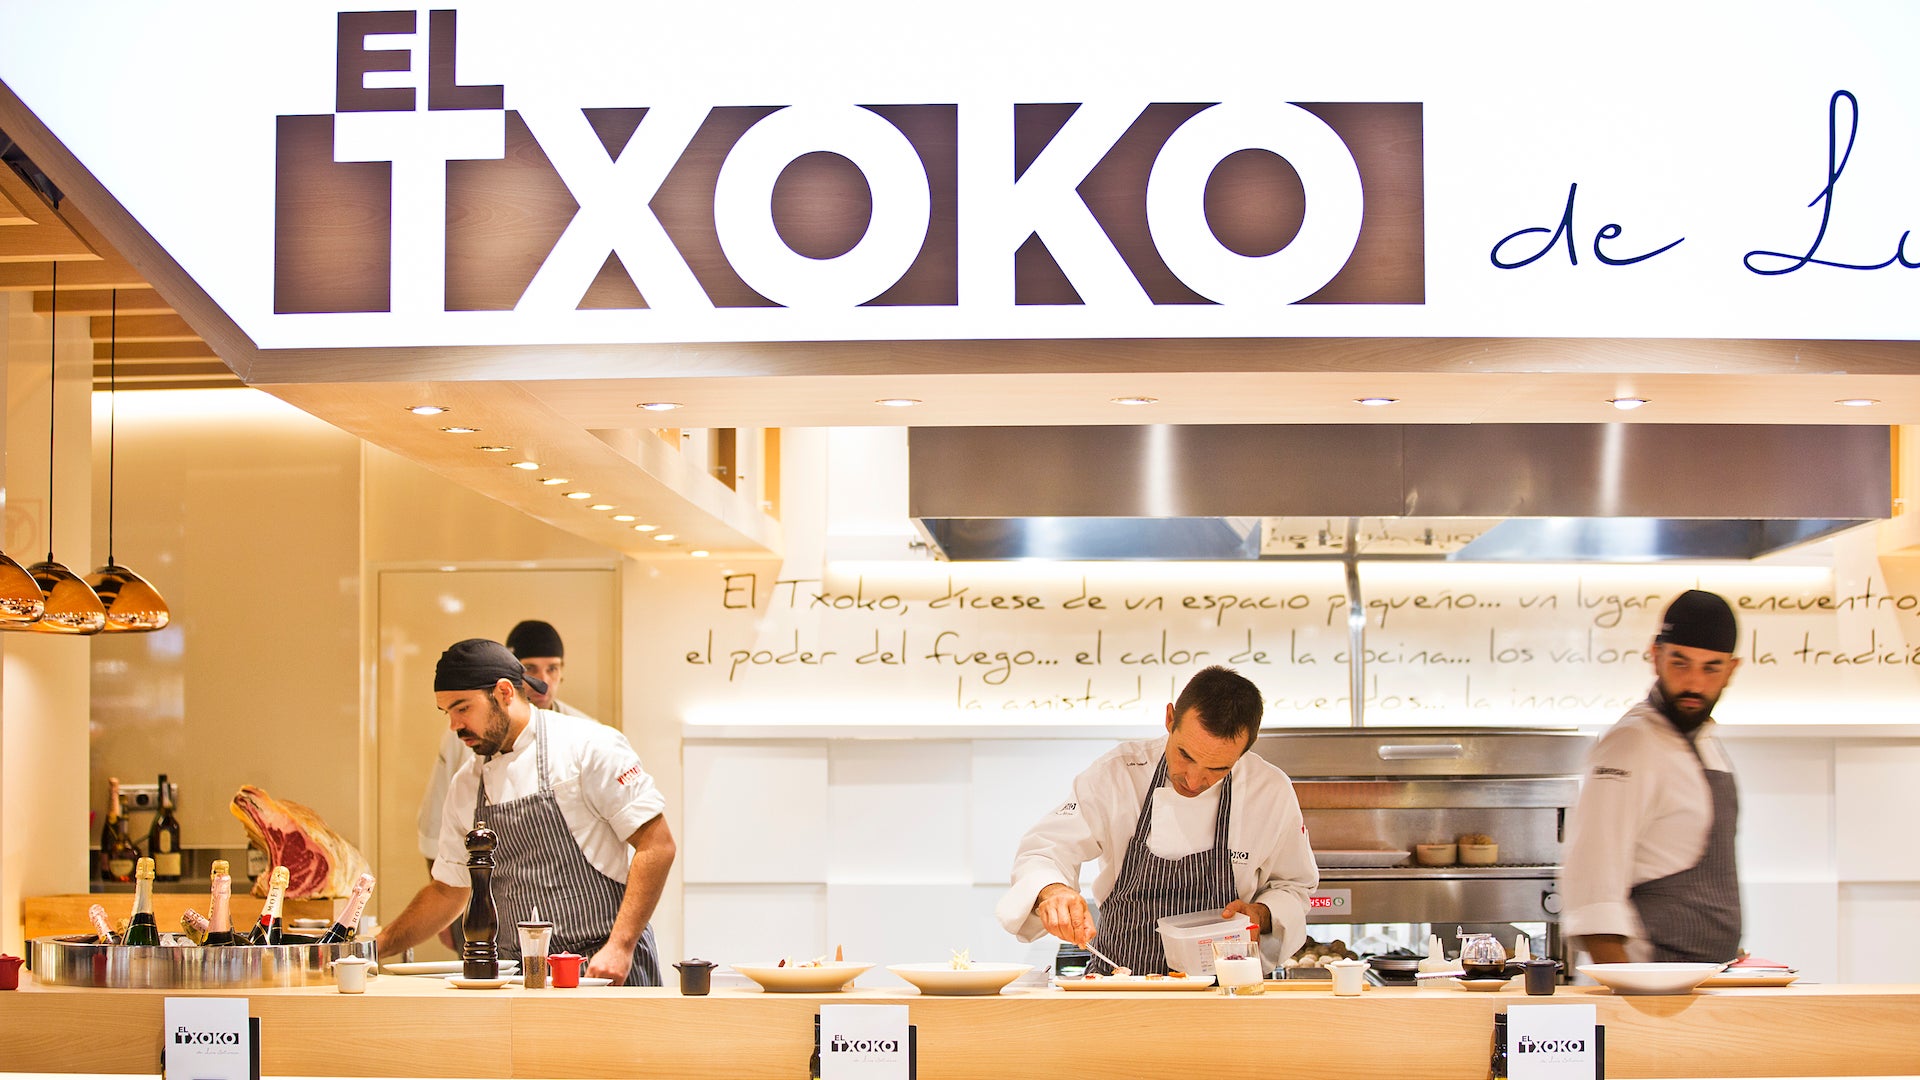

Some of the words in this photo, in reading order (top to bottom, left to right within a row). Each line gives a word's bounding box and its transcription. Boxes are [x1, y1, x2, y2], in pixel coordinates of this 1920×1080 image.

[336, 9, 504, 112] EL
[330, 100, 1366, 312] TXOKO
[1491, 183, 1685, 269] de
[722, 572, 757, 610] El
[774, 574, 909, 616] Txoko,
[1061, 575, 1108, 611] de
[1124, 594, 1165, 612] un
[1181, 593, 1311, 627] espacio
[1327, 588, 1500, 630] pqueño...
[1518, 592, 1558, 610] un
[1576, 575, 1661, 629] lugar
[685, 627, 713, 665] el
[729, 627, 838, 683] poder
[854, 627, 907, 665] del
[924, 630, 1059, 685] fuego...
[1074, 628, 1102, 666] el
[1119, 628, 1210, 665] calor
[1228, 627, 1273, 664] de
[1290, 627, 1317, 664] la
[1489, 625, 1535, 664] los
[1550, 628, 1656, 664] valore
[1752, 628, 1777, 664] la
[176, 1032, 239, 1045] TXOKO
[831, 1040, 898, 1053] TXOKO
[1518, 1040, 1585, 1053] TXOKO
